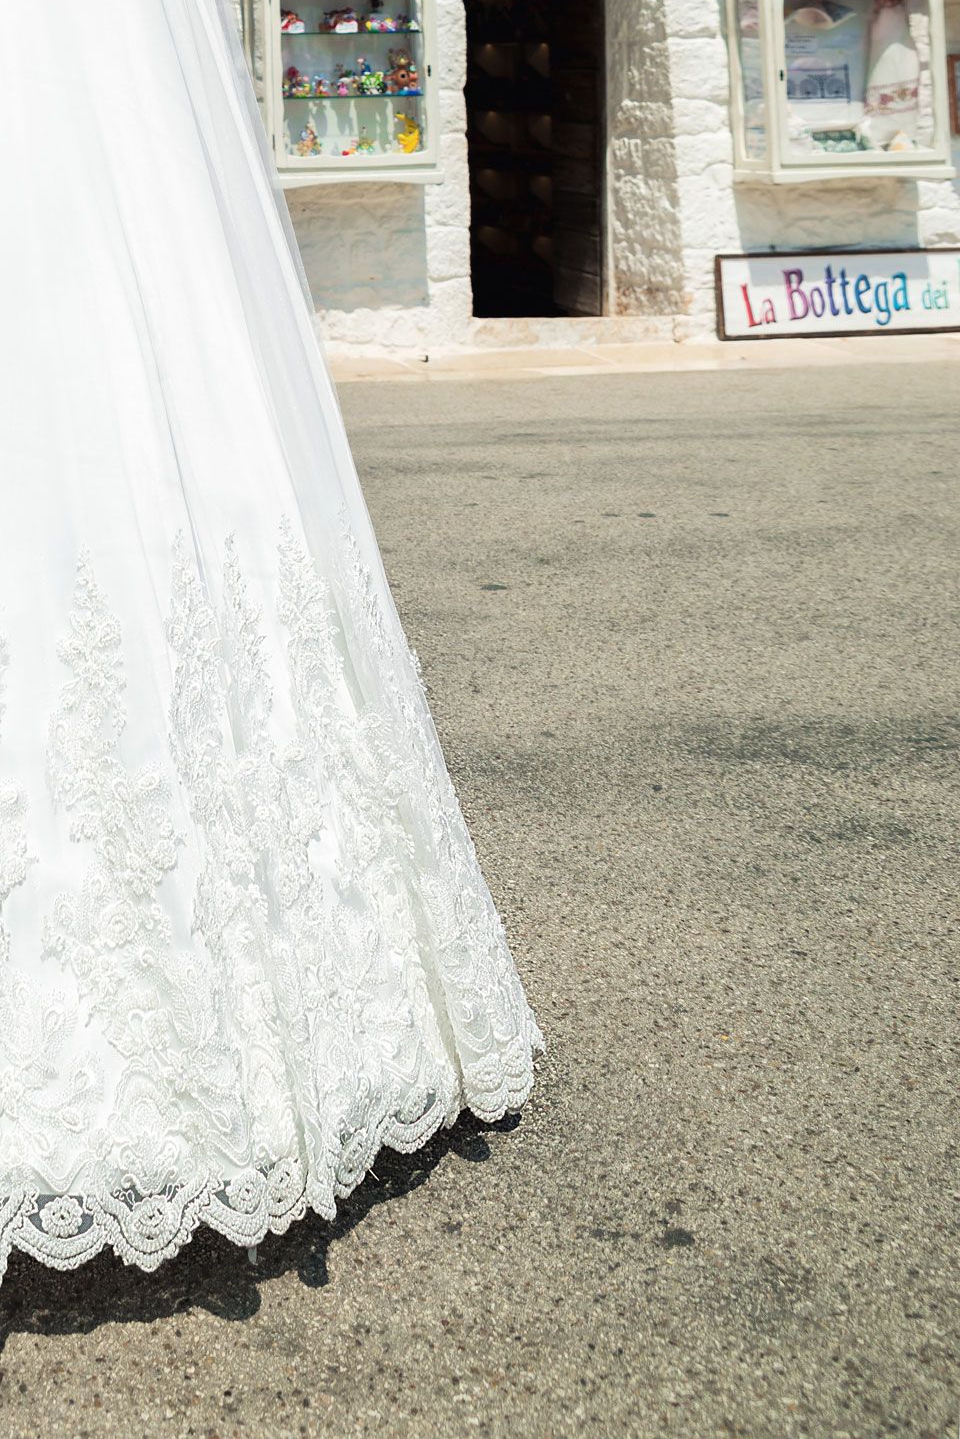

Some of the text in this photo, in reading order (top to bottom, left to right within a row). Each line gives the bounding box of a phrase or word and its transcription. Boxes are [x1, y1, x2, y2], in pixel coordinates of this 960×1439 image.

[741, 283, 776, 328] La
[783, 263, 910, 326] Bottega
[922, 280, 949, 310] dei
